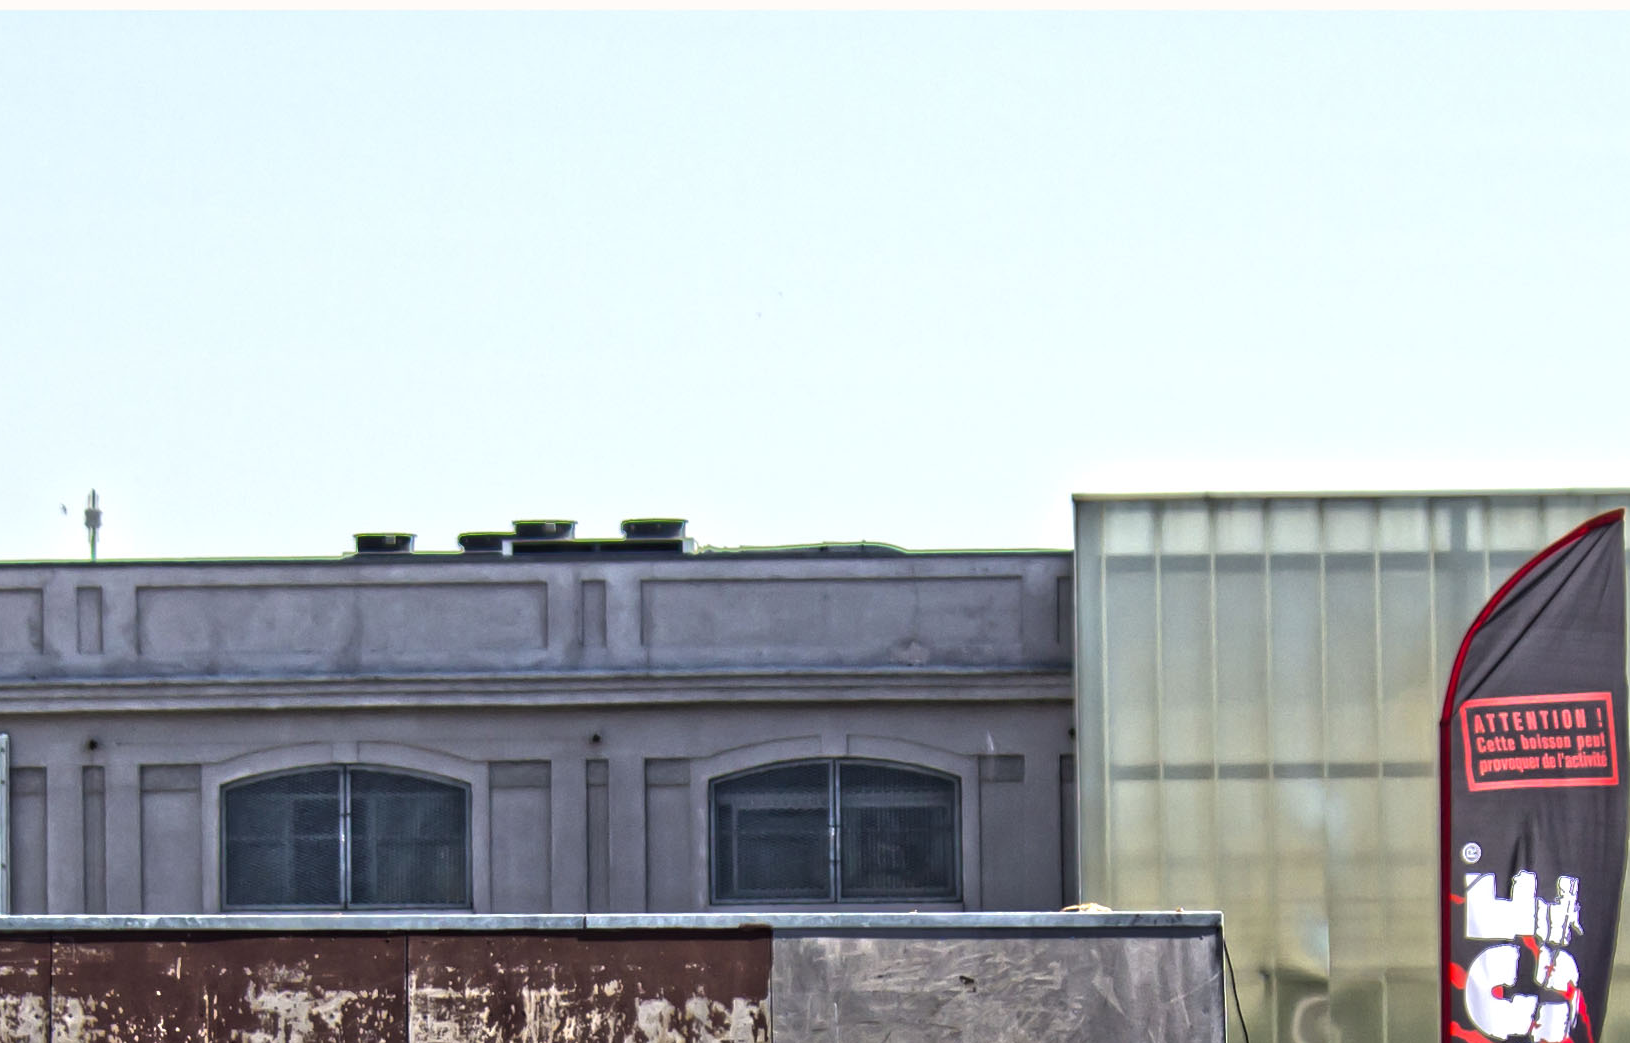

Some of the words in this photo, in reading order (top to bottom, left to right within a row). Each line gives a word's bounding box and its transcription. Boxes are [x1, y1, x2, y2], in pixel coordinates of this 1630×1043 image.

[1473, 708, 1587, 734] ATTENTION
[1475, 735, 1517, 754] Cette
[1520, 733, 1572, 751] boisson
[1576, 731, 1607, 752] peut
[1478, 755, 1540, 776] provoquer
